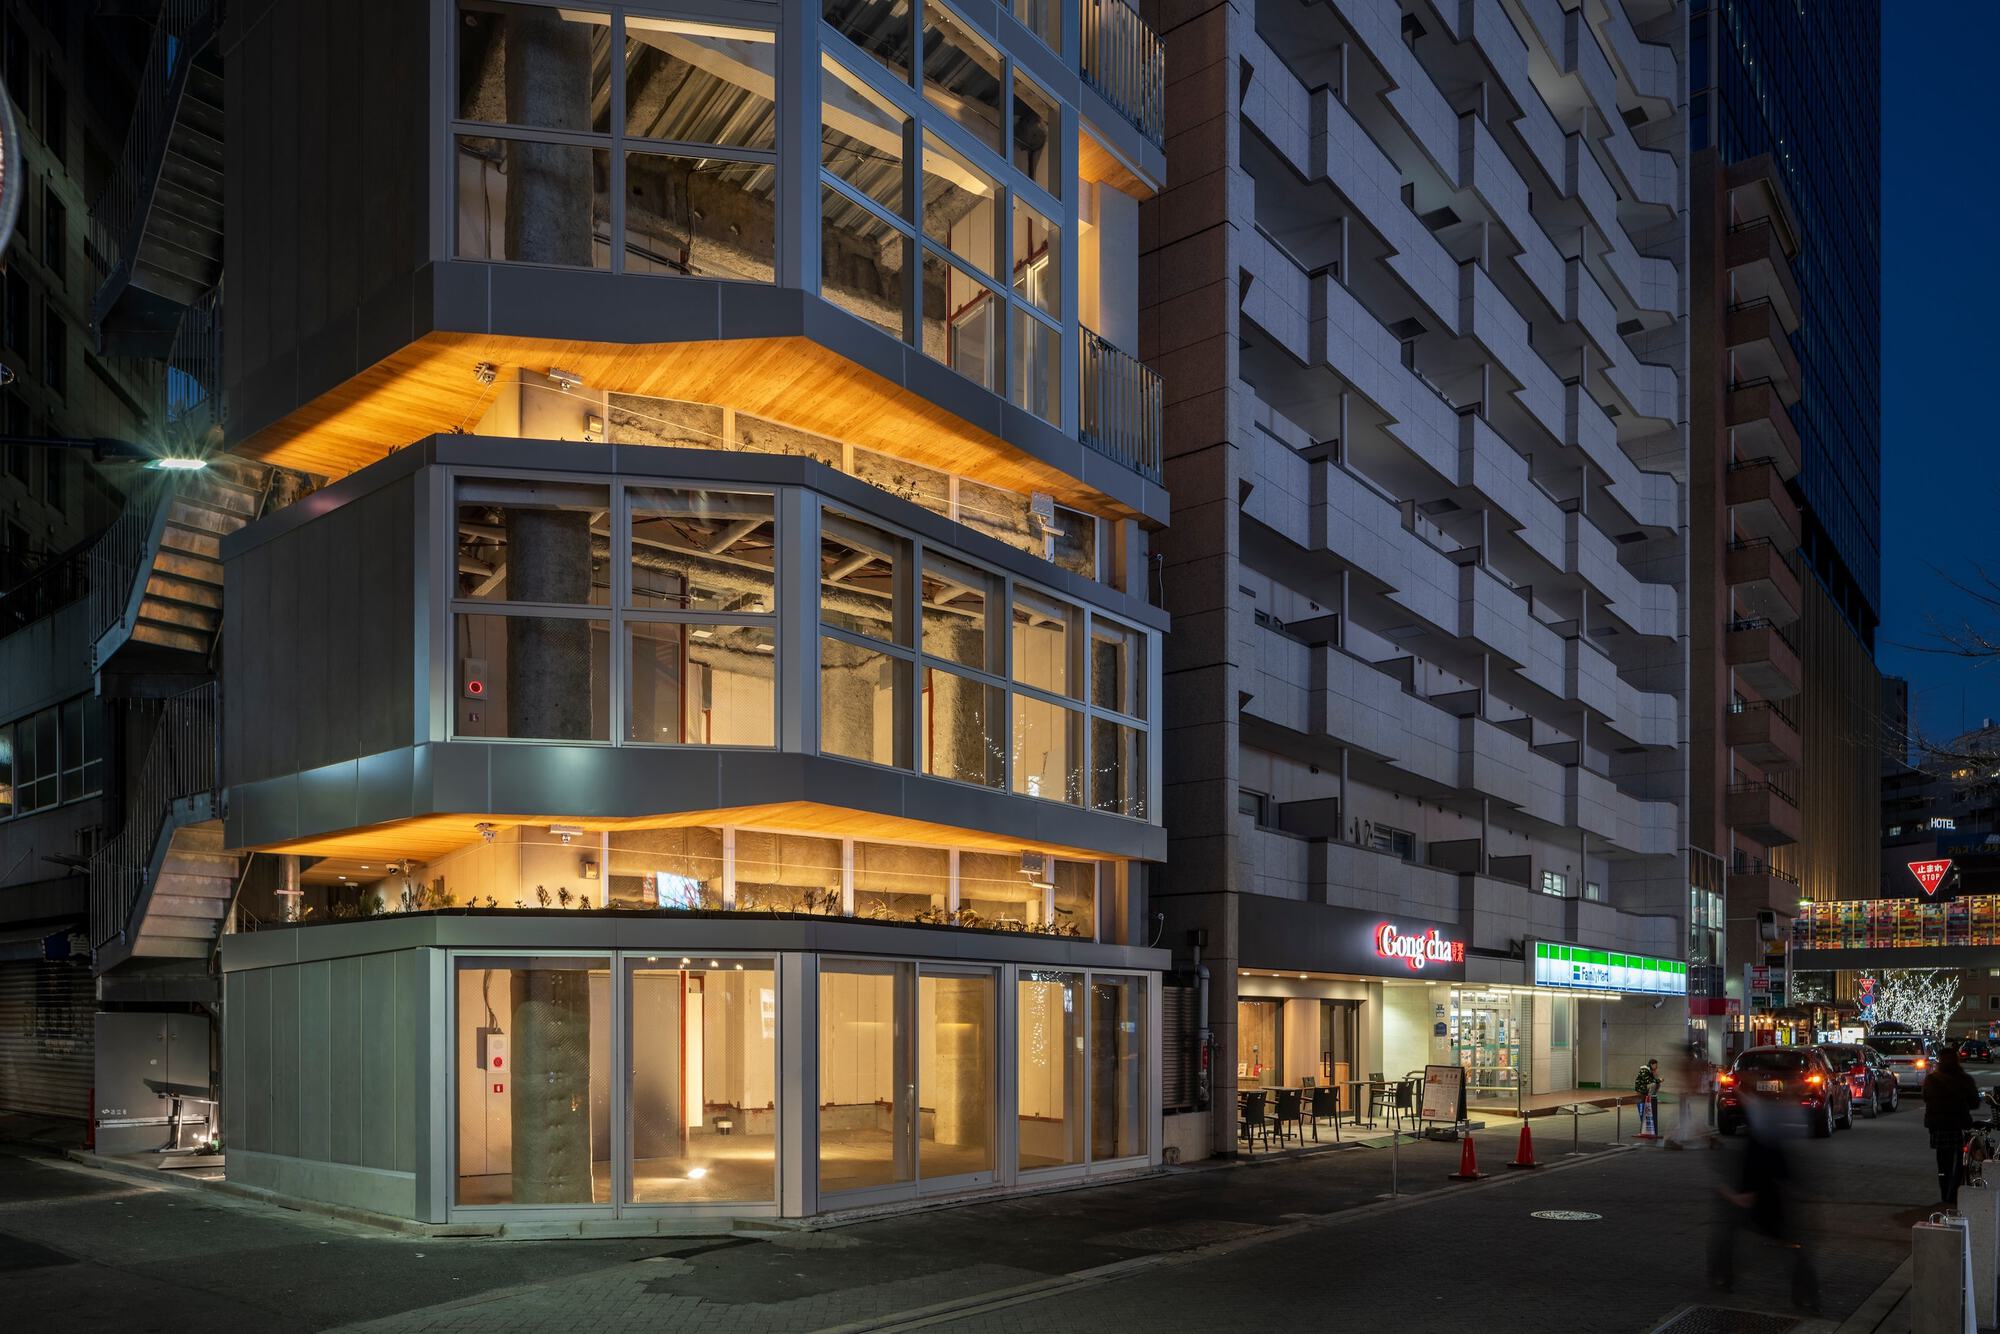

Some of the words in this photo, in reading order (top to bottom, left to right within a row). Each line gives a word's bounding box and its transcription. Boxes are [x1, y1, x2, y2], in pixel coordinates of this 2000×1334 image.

[1930, 817, 1956, 830] HOTEL
[1917, 864, 1944, 874] 止まれ
[1921, 873, 1940, 882] STOP
[1381, 924, 1426, 969] Gong
[1426, 929, 1453, 962] cha
